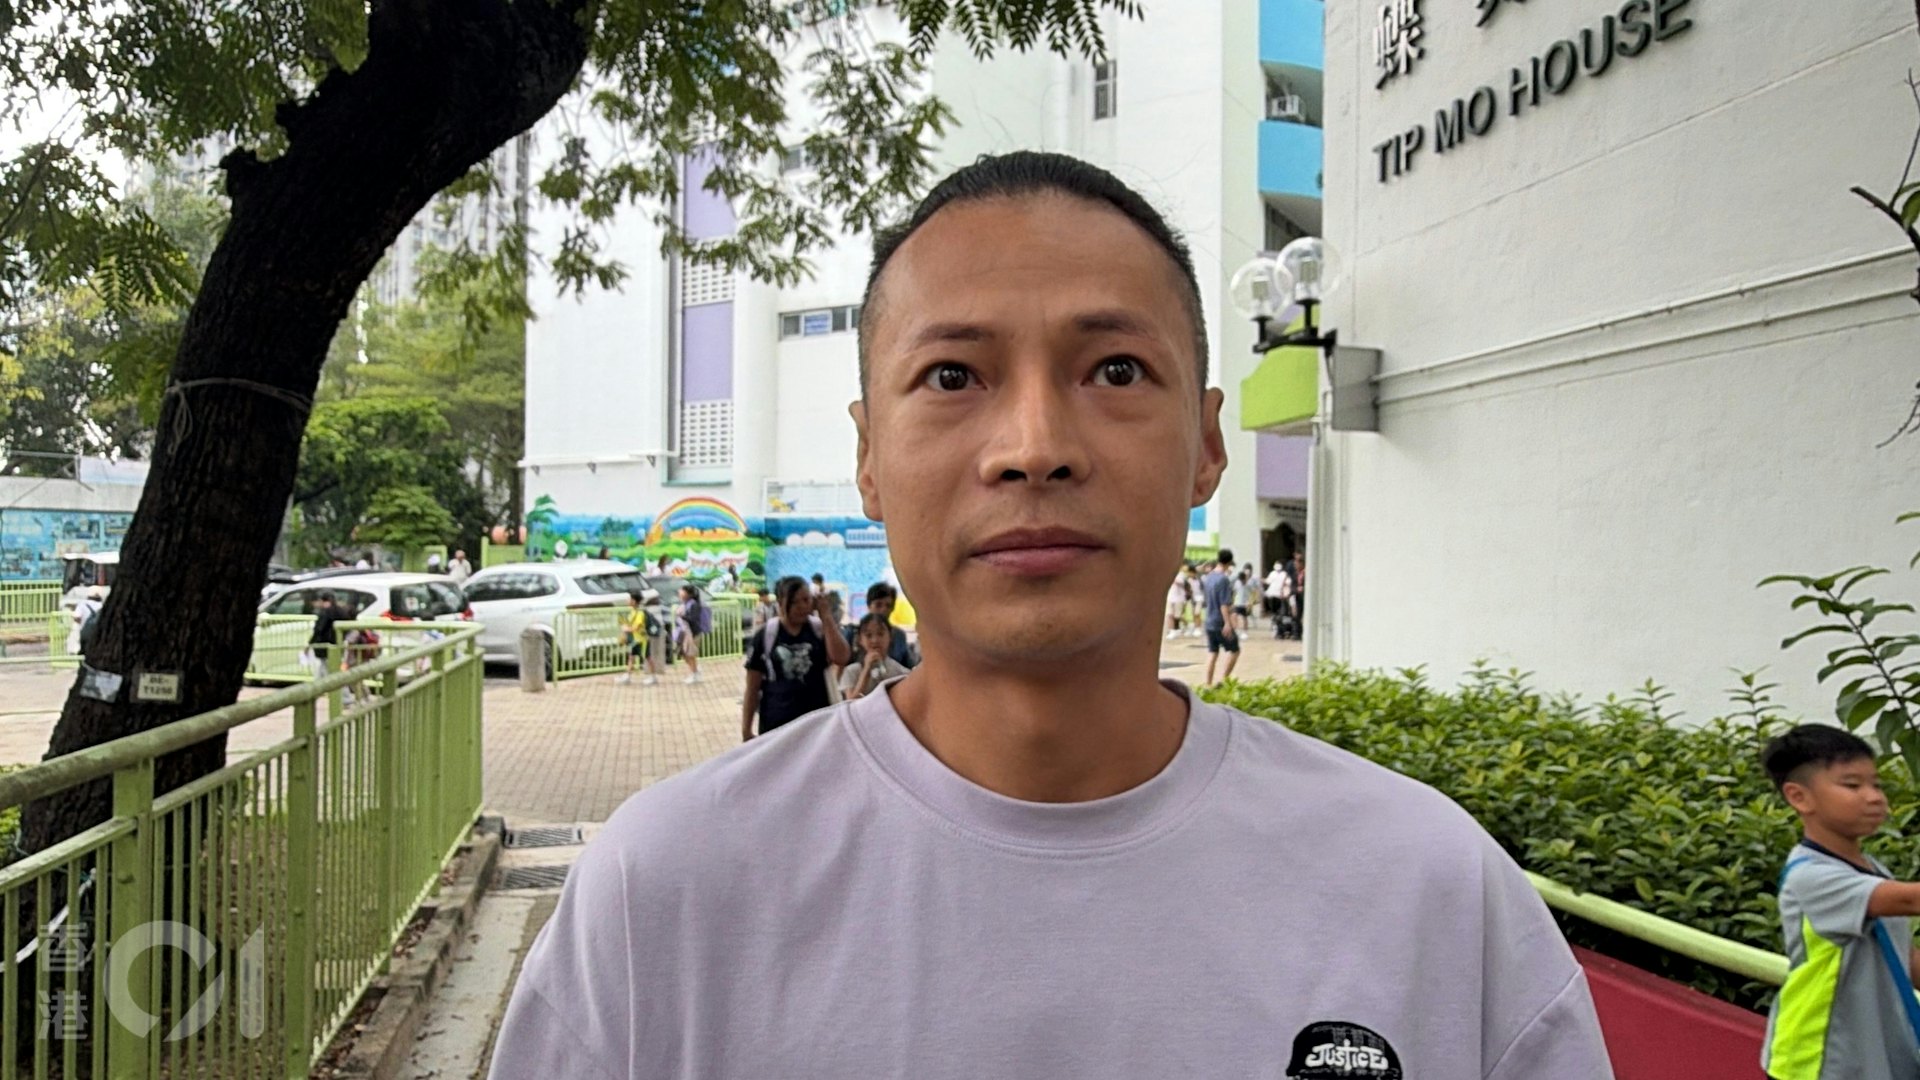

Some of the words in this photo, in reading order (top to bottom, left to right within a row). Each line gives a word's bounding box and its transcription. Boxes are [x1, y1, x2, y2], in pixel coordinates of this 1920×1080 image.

[1373, 124, 1425, 183] TIP
[1434, 86, 1497, 154] MO
[1508, 0, 1694, 117] HOUSE
